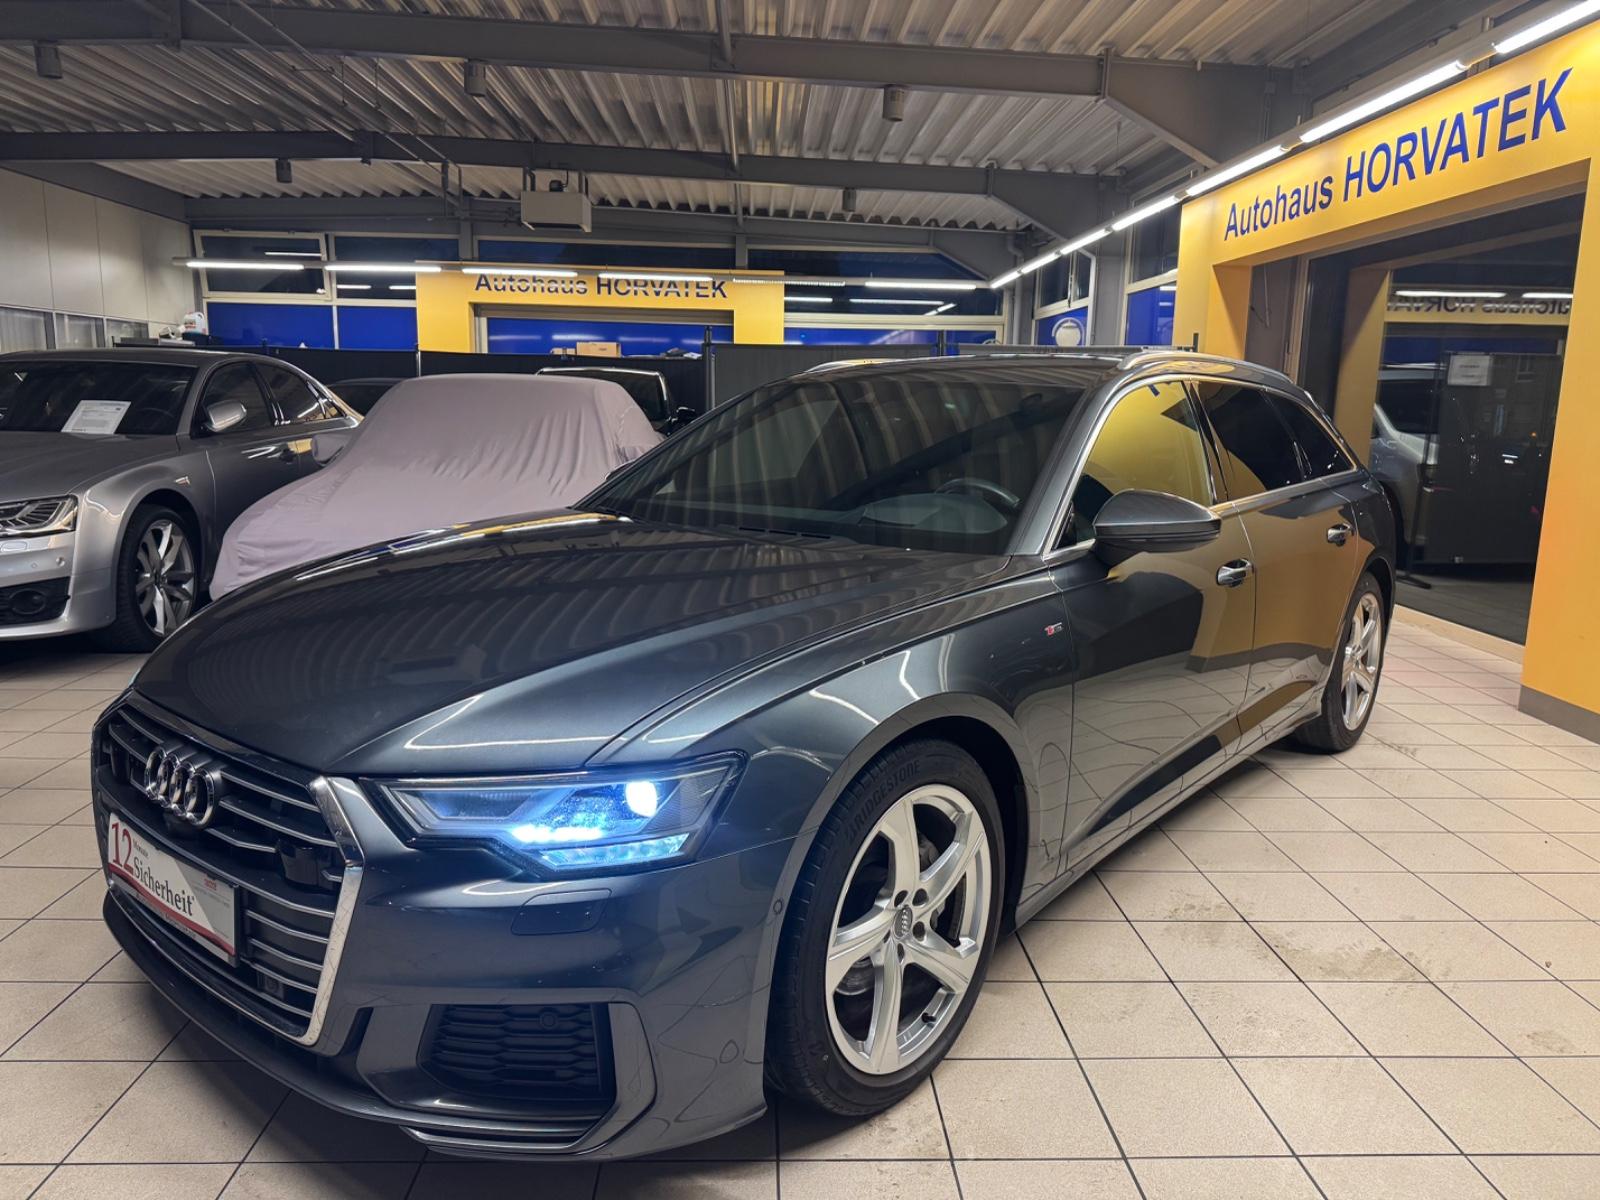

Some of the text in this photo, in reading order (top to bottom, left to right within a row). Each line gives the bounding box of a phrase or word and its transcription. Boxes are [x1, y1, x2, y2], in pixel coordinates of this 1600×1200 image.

[1224, 67, 1573, 241] Autohaus HORVATEK
[475, 274, 728, 298] Autohaus HORVATEK
[847, 760, 921, 841] BRIDGESTONE
[112, 822, 133, 875] 12
